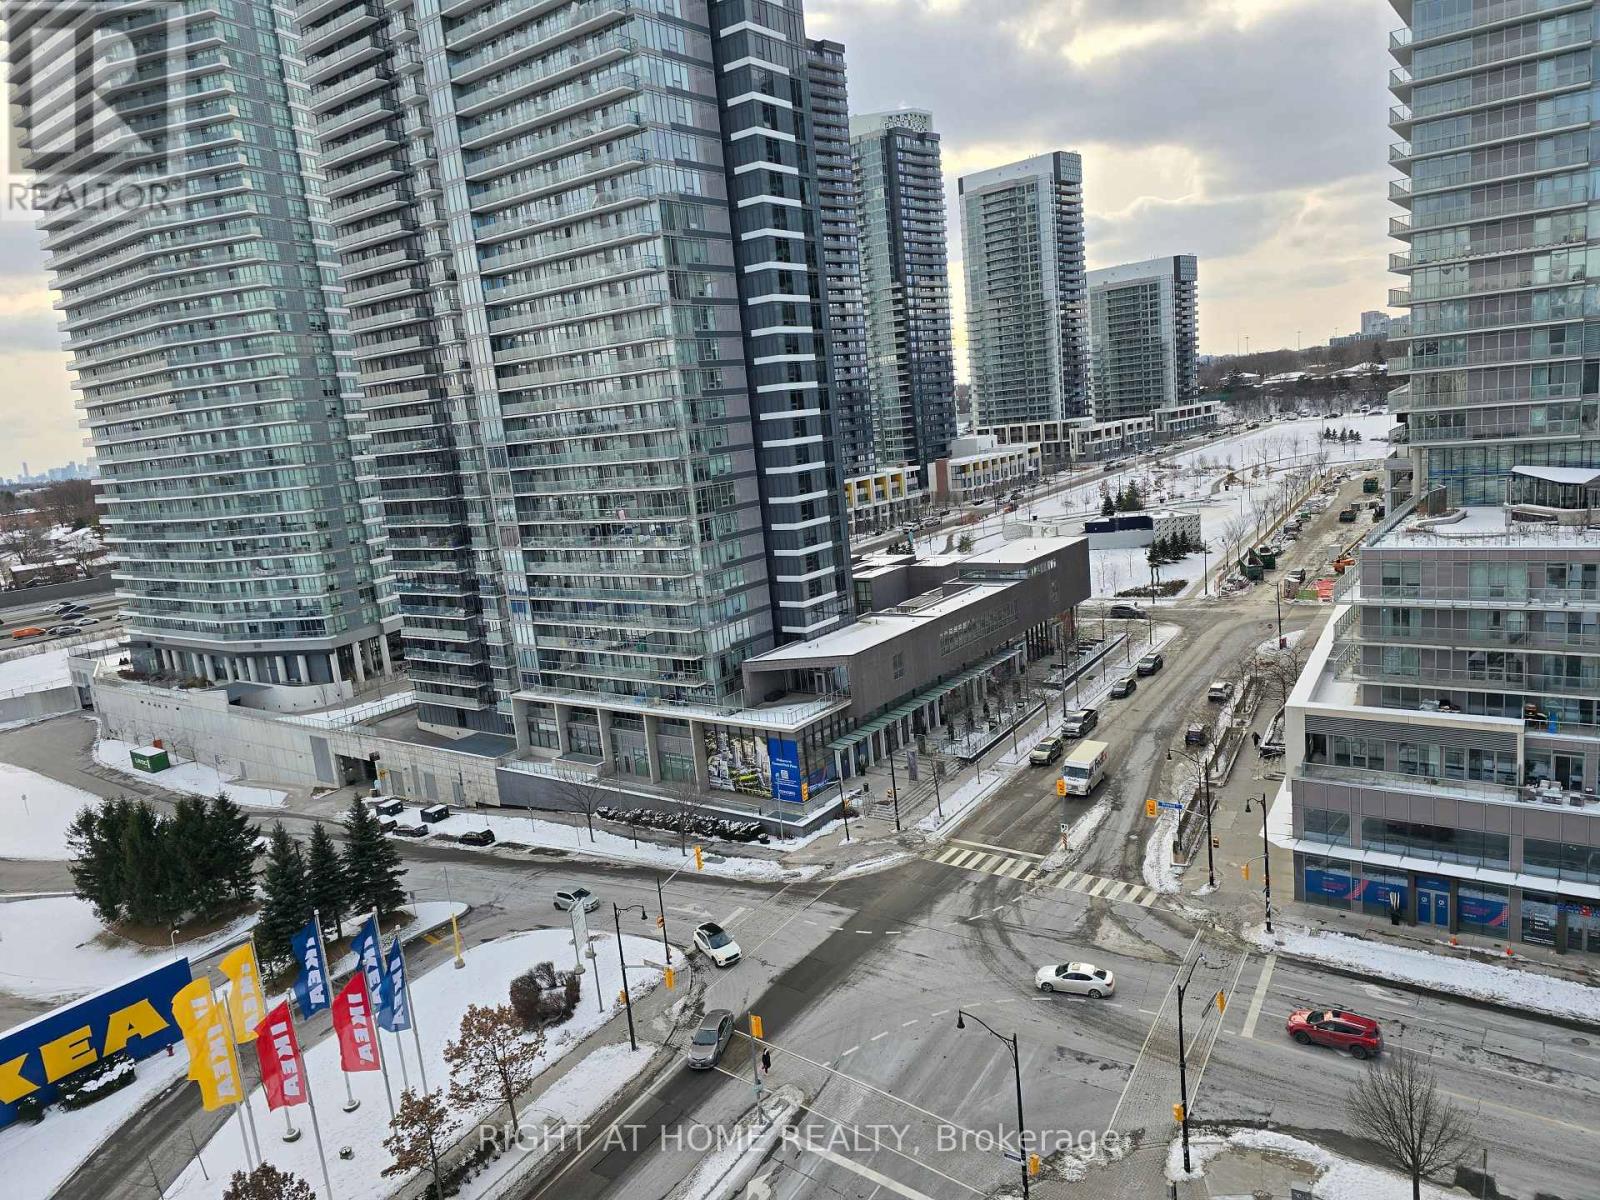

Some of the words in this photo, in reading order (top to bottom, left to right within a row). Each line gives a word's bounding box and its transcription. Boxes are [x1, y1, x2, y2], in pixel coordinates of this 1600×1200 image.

[305, 937, 325, 1004] IKEA
[363, 935, 382, 1004] IKEA
[207, 1023, 237, 1097] IKEA
[270, 1022, 300, 1096] IKEA
[347, 993, 375, 1064] IKEA
